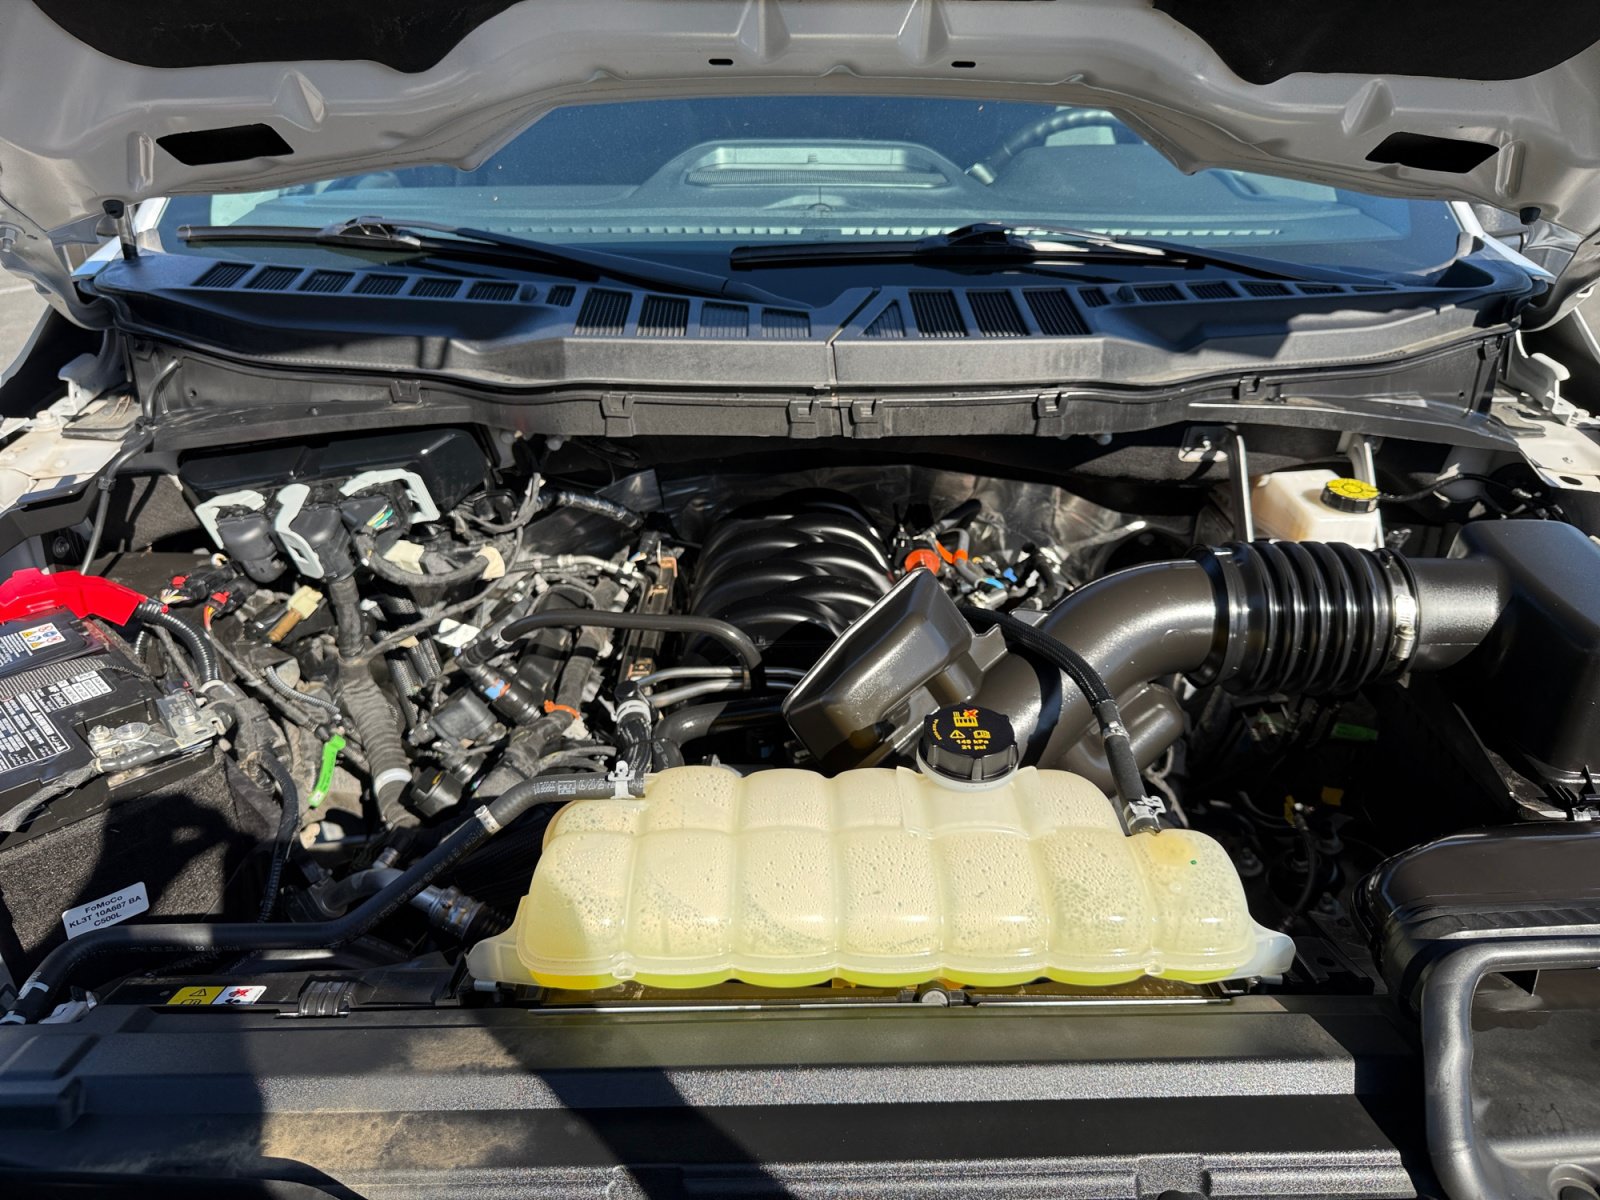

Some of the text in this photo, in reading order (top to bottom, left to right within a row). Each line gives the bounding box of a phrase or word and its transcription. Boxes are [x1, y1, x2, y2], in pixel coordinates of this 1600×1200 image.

[69, 895, 142, 928] KL3T 10A687 BA
[84, 895, 123, 914] FoMoCo
[93, 912, 122, 927] C500L
